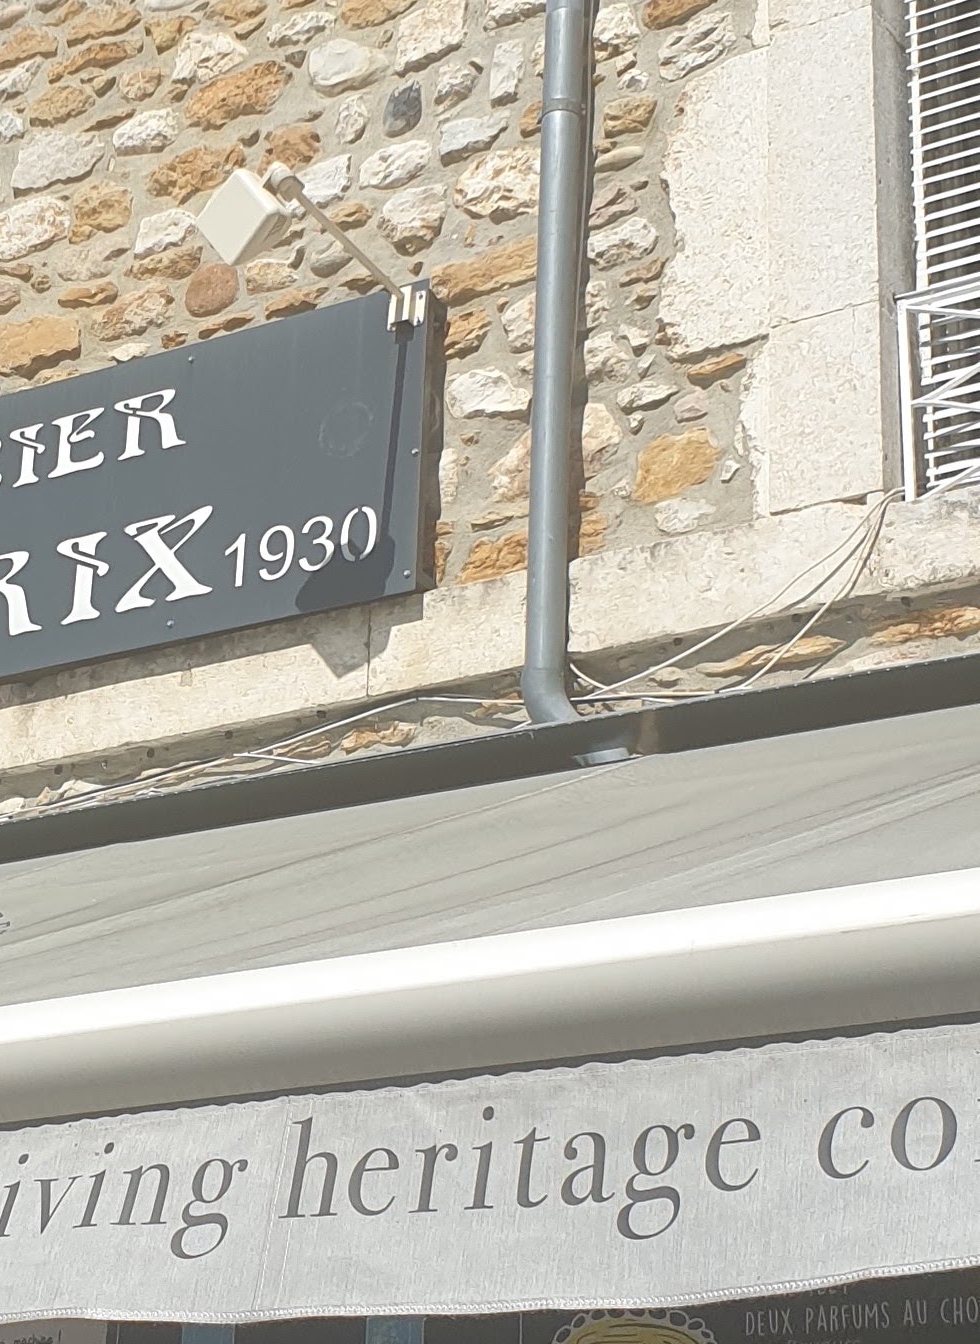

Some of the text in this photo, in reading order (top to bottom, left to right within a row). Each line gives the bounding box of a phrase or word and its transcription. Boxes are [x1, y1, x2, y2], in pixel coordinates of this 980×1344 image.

[224, 505, 378, 589] 1930
[278, 1107, 762, 1241] heritage
[818, 1096, 980, 1179] co
[745, 1296, 980, 1336] DEUX PARFUMS AU CHO
